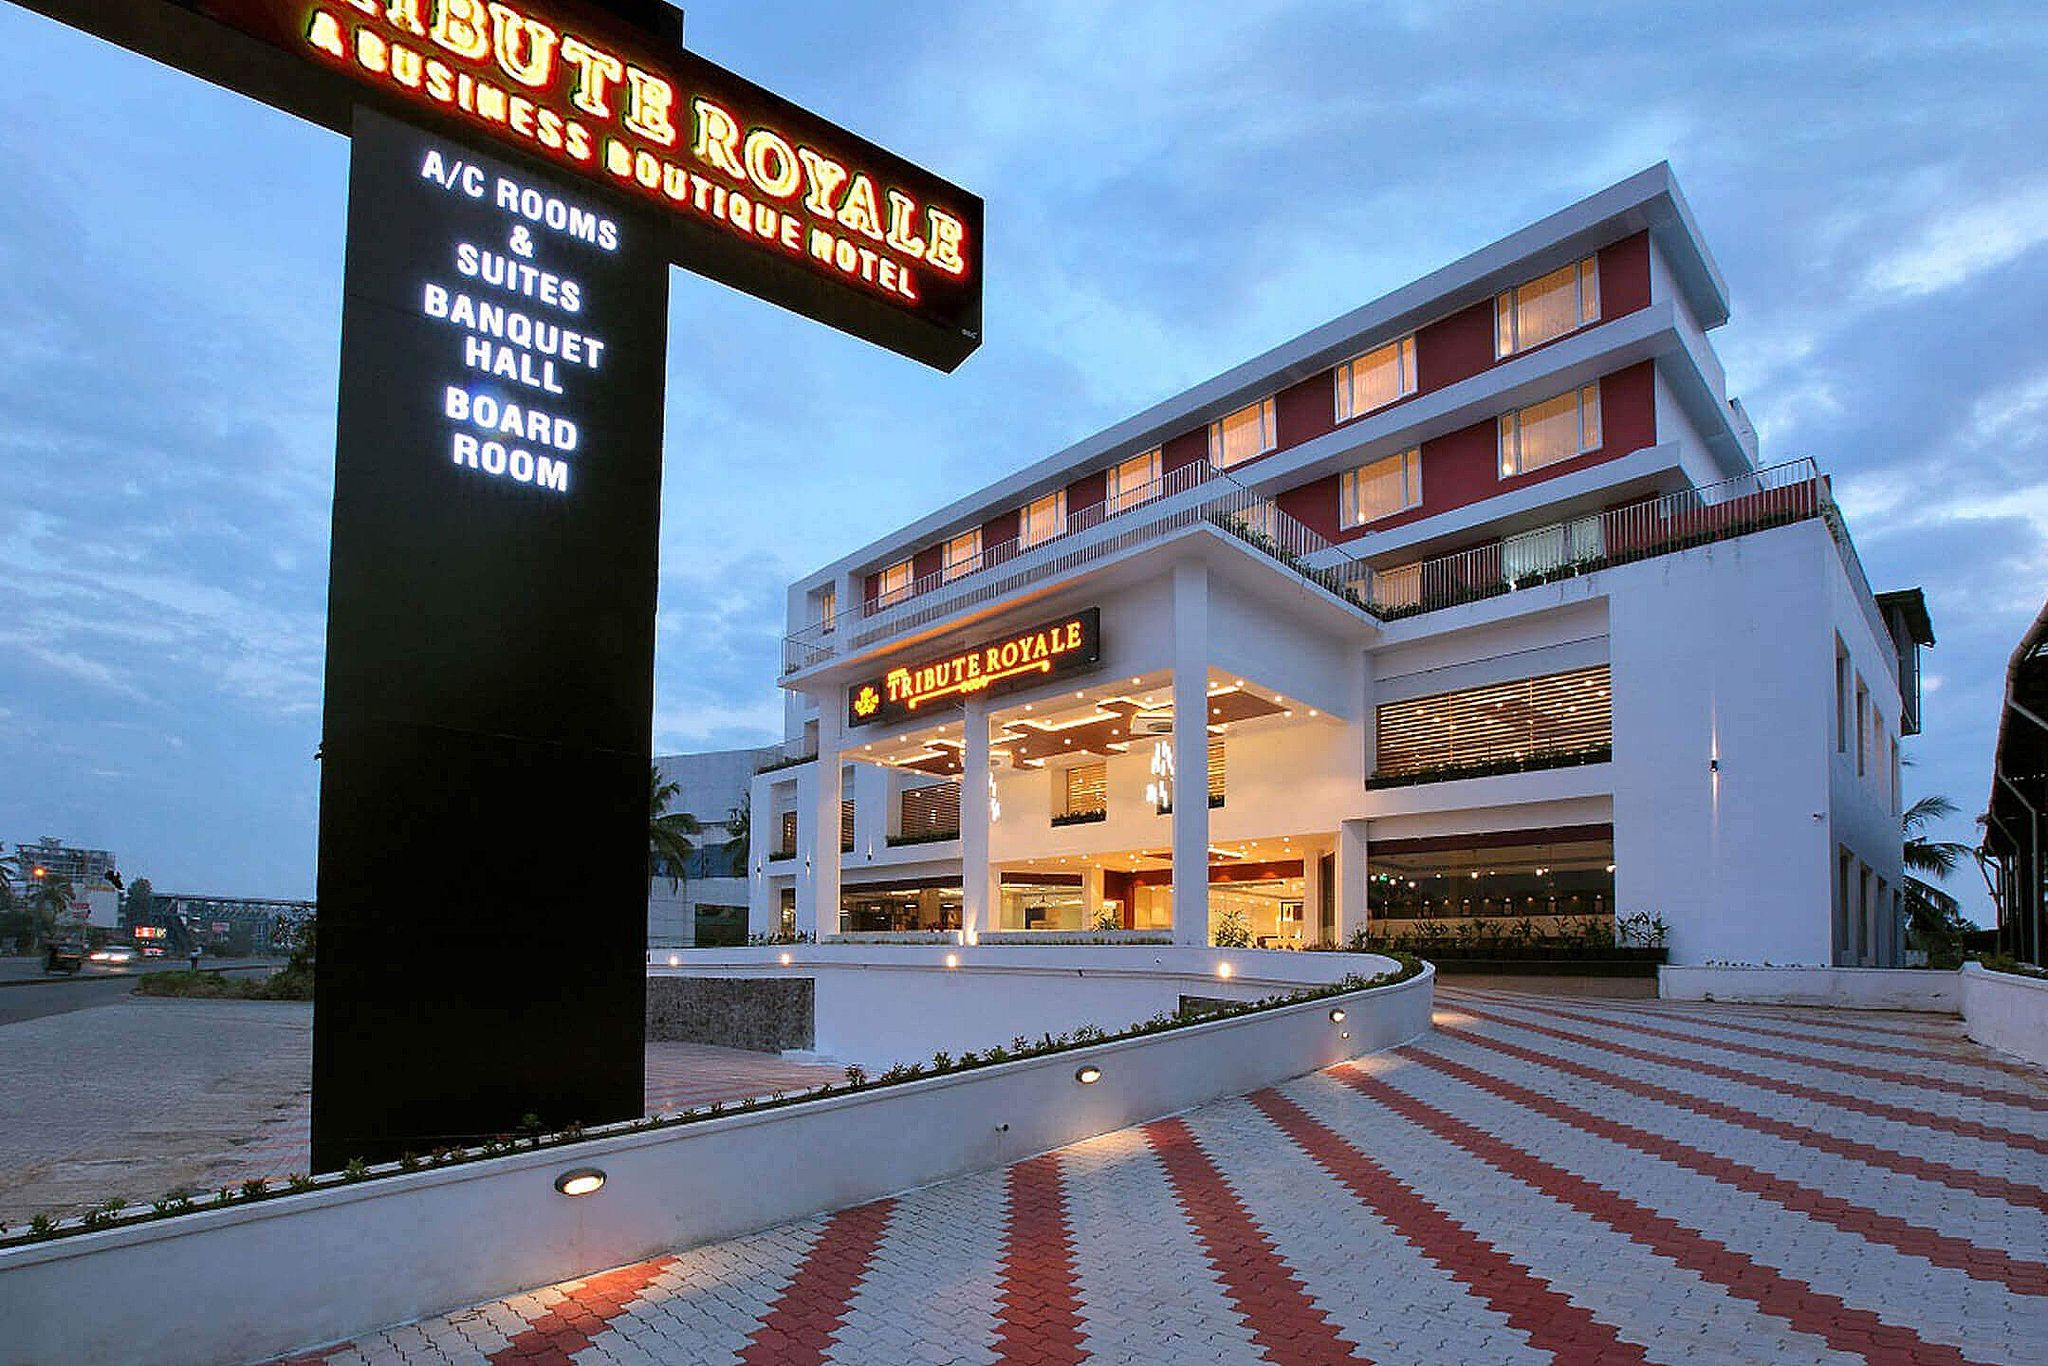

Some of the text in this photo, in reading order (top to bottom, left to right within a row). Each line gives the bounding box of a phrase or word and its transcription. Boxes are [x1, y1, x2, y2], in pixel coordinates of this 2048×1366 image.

[308, 9, 917, 300] A BUSINESS BOUTIQUE HOTEL
[347, 0, 966, 275] BUTE ROYALE
[421, 149, 618, 251] A/C ROOMS
[456, 242, 580, 312] SUITES
[509, 224, 534, 258] &
[424, 283, 605, 369] BANQUET
[465, 336, 564, 395] HALL
[445, 386, 578, 451] BOARD
[453, 432, 568, 492] ROOM
[887, 621, 1083, 702] TRIBUTE ROYALE
